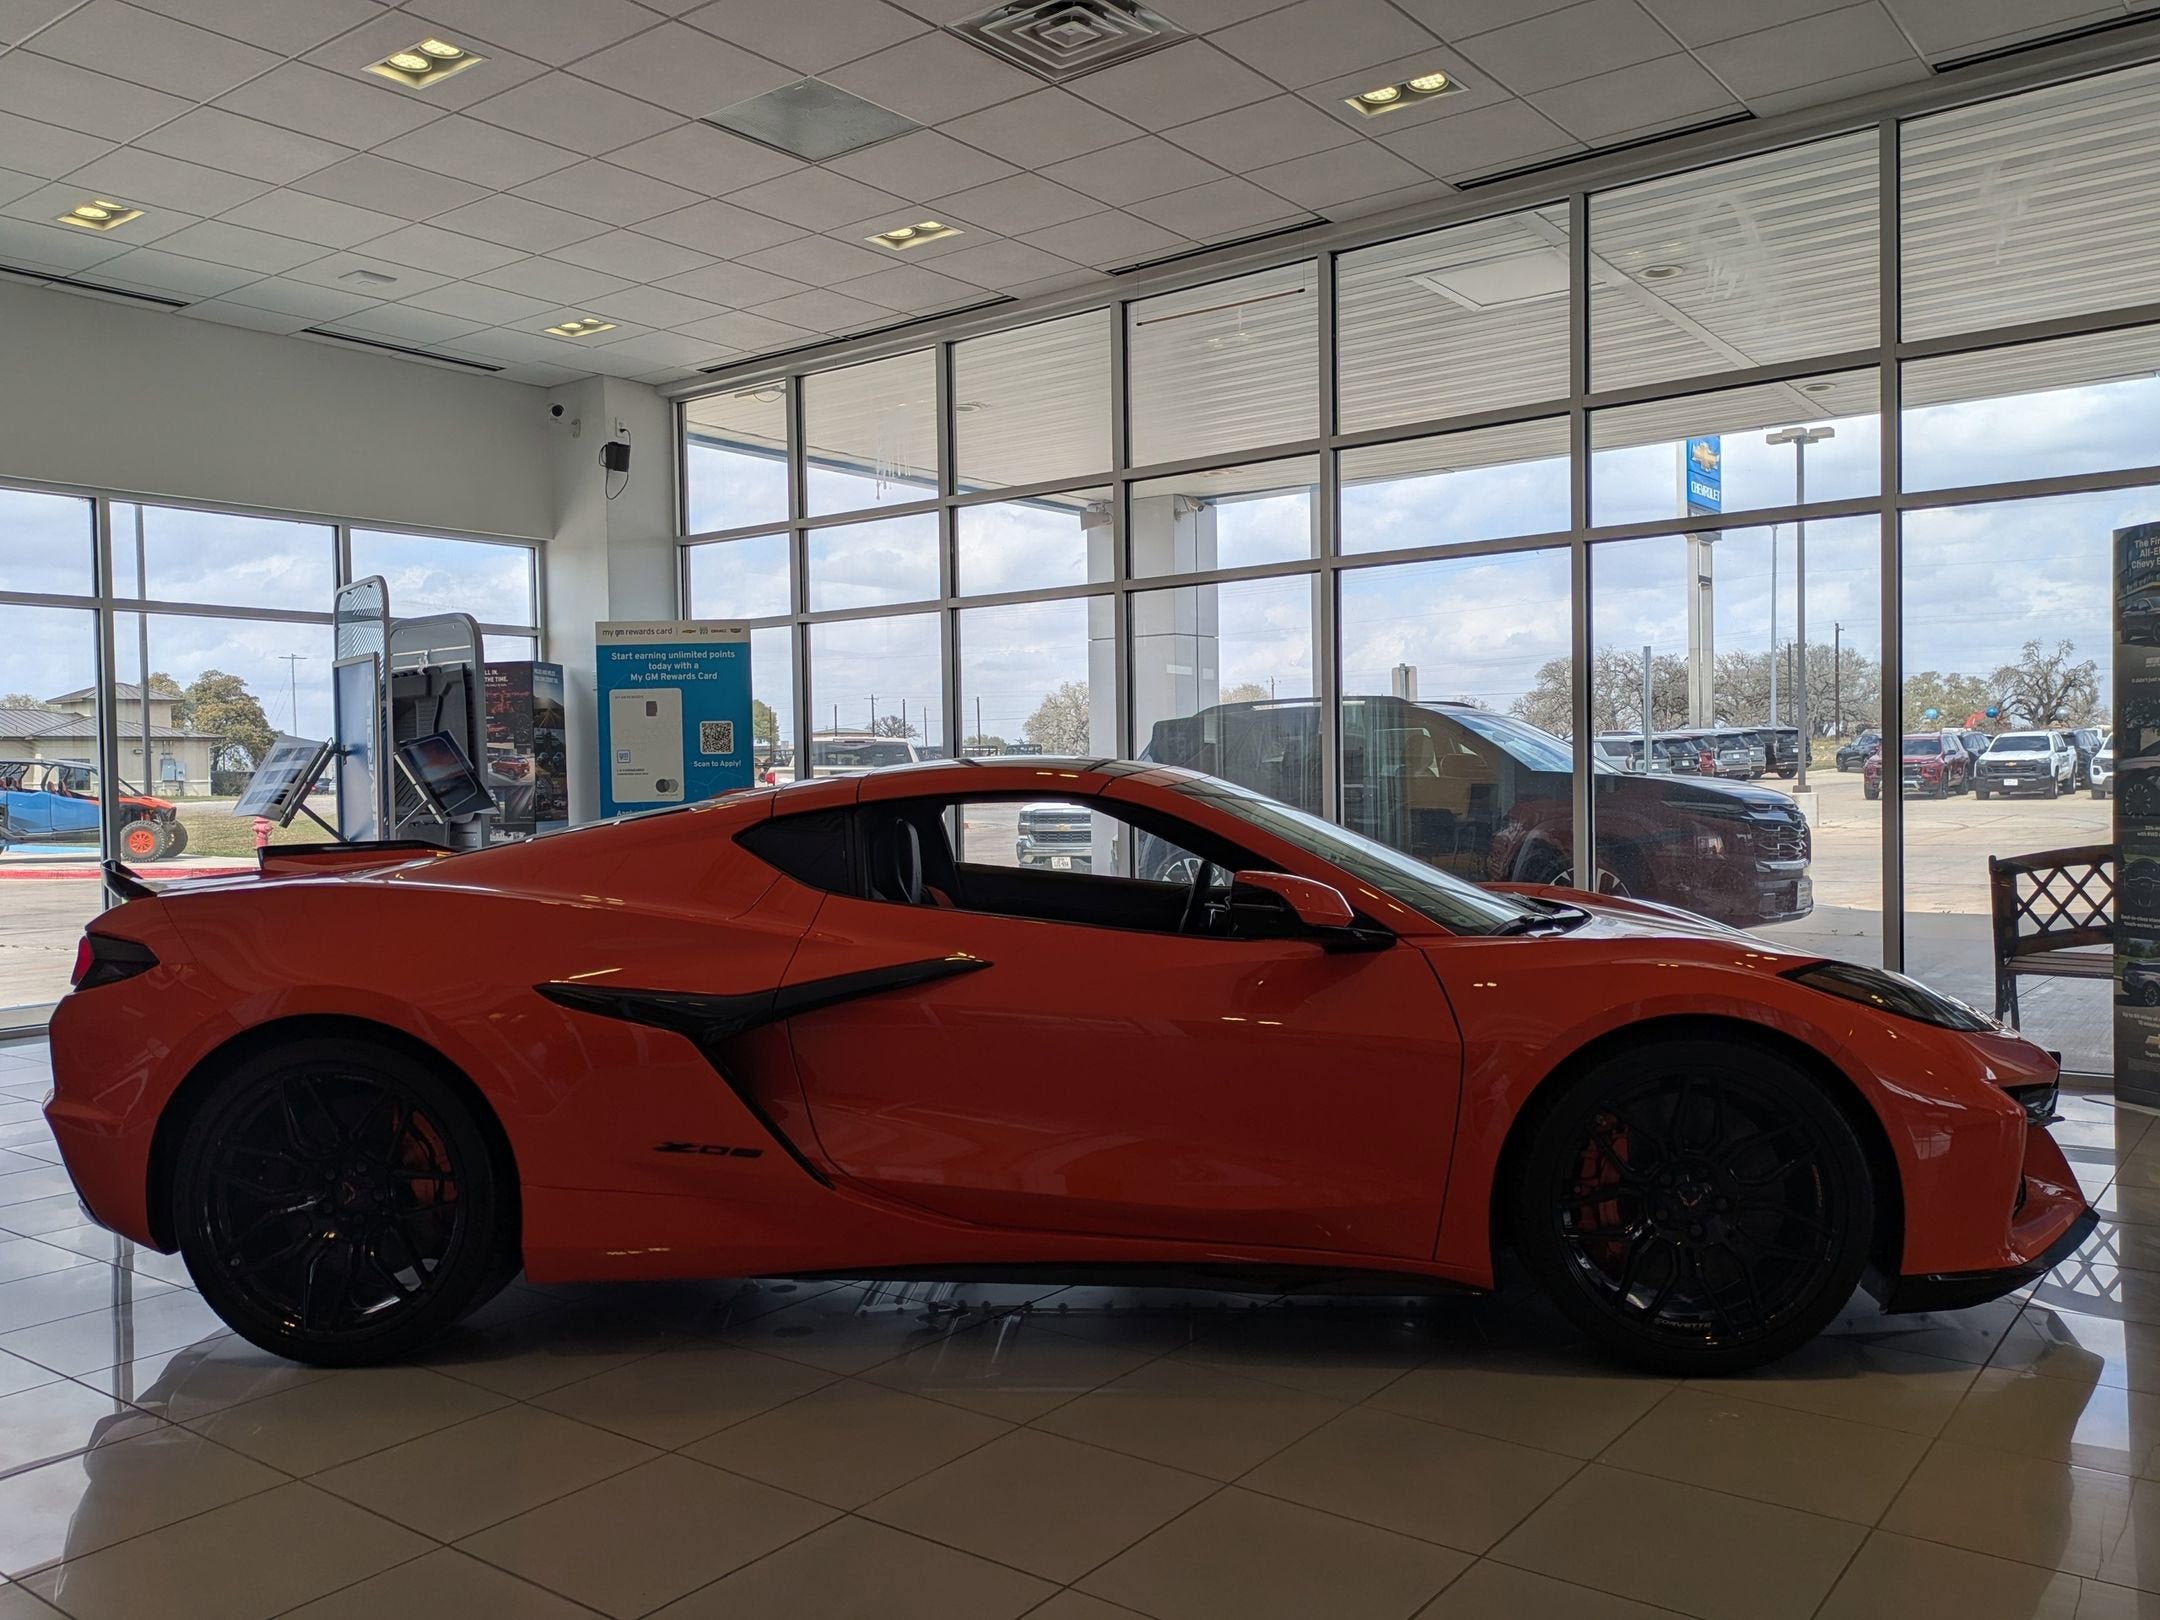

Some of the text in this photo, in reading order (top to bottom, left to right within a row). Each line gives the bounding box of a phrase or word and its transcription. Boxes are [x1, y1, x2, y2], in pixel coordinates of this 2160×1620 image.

[1691, 480, 1720, 502] CHEVROLET
[2134, 539, 2149, 549] The
[2131, 559, 2155, 569] Chevy
[602, 627, 673, 638] my gm rewards card
[611, 650, 736, 661] Start earning unlimited points
[648, 662, 672, 671] today
[674, 661, 692, 670] with
[630, 671, 718, 682] My GM Rewards Card
[693, 759, 741, 768] Scan to Apply!
[652, 1141, 764, 1158] Z06
